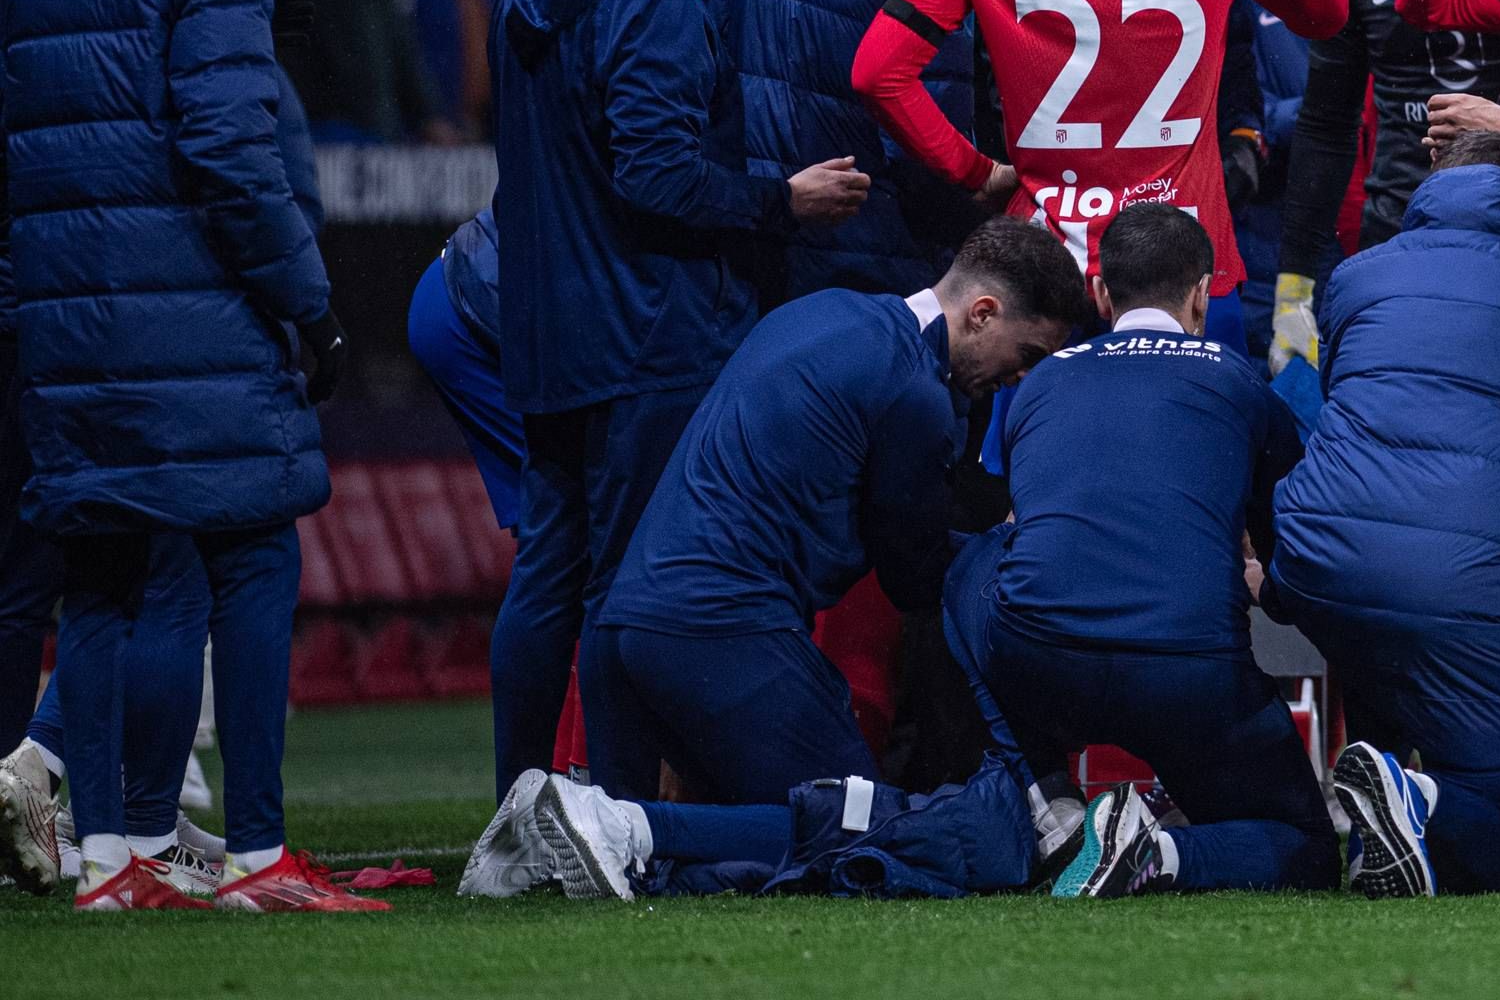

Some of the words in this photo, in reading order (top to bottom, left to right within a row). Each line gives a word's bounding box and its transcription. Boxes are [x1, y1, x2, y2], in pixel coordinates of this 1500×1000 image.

[1035, 169, 1114, 218] ria
[1104, 337, 1222, 353] vithas
[1097, 349, 1127, 357] vivir
[1128, 349, 1161, 357] para
[1164, 349, 1222, 363] cuidarte
